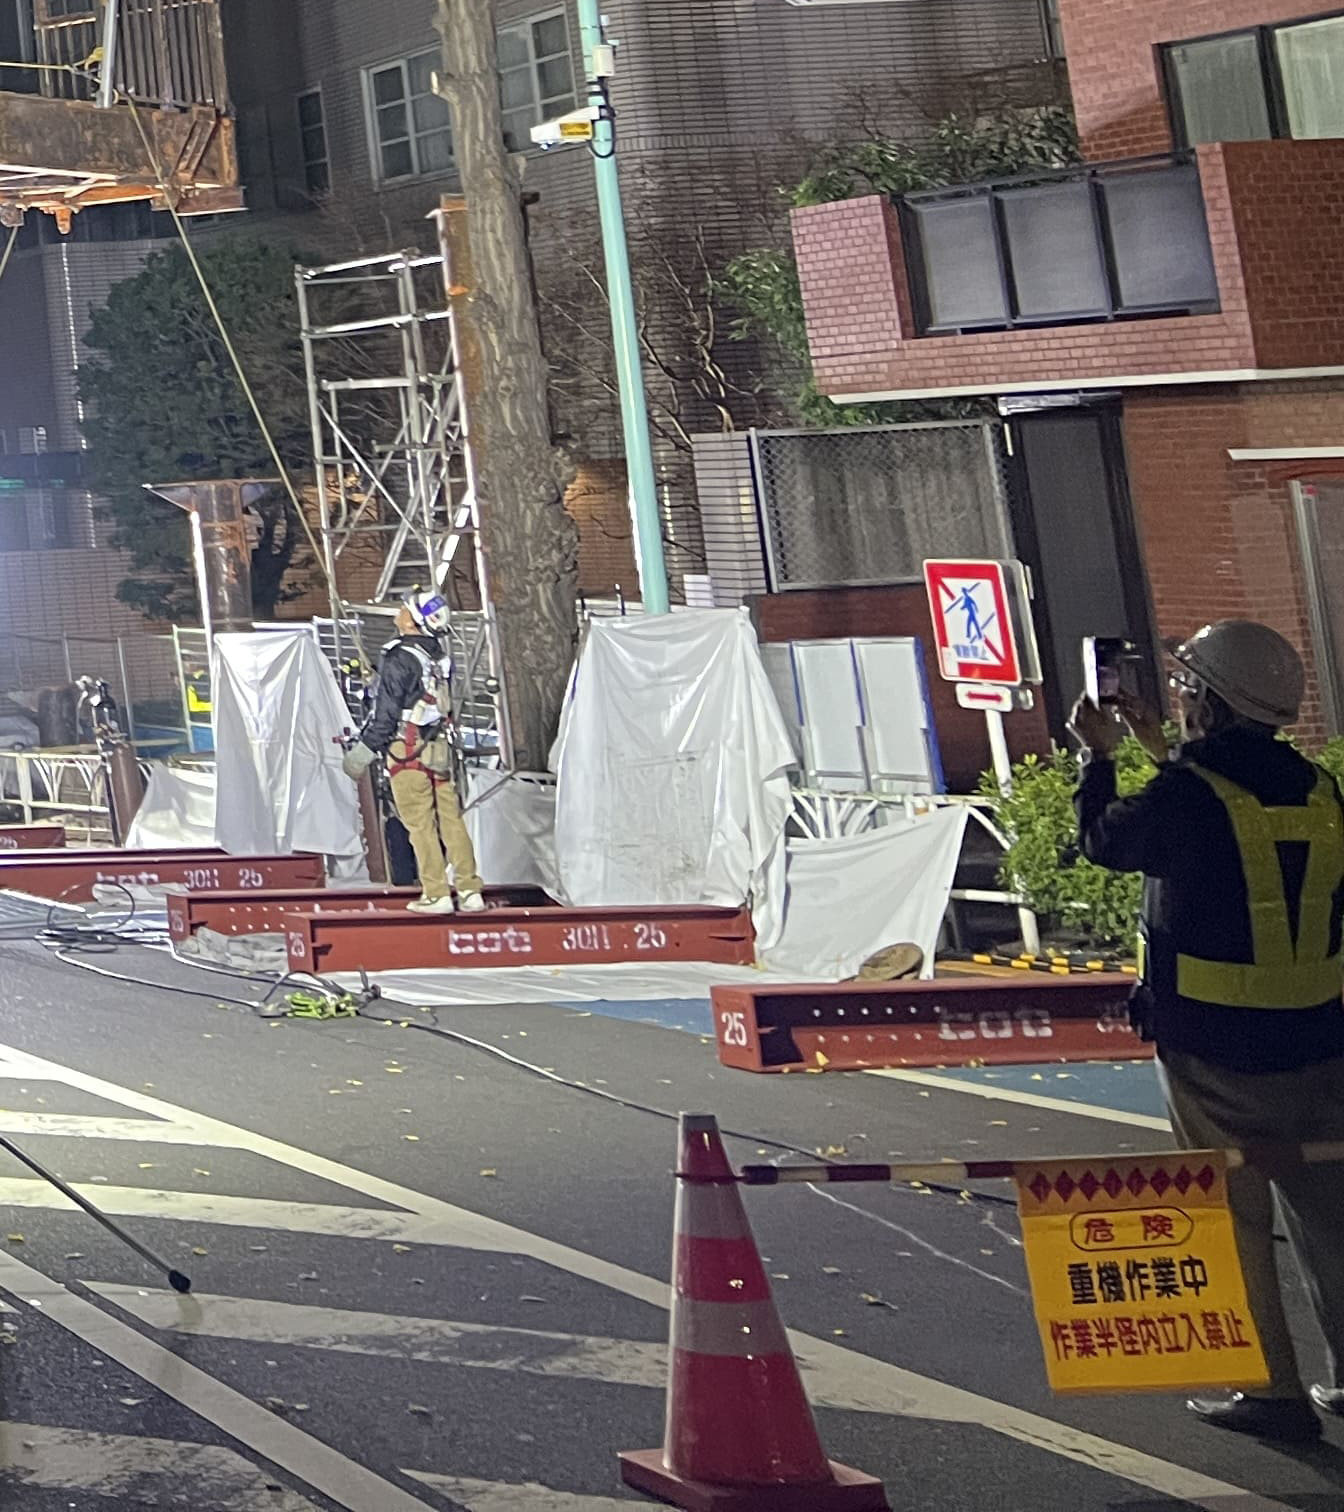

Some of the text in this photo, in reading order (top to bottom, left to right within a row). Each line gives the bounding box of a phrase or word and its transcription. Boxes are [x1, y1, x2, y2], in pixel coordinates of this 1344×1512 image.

[633, 922, 667, 950] 25
[720, 1011, 748, 1047] 25
[1084, 1214, 1174, 1245] 危険
[1067, 1254, 1209, 1305] 重機作業中
[1050, 1308, 1252, 1362] 作業半径内立入禁止
